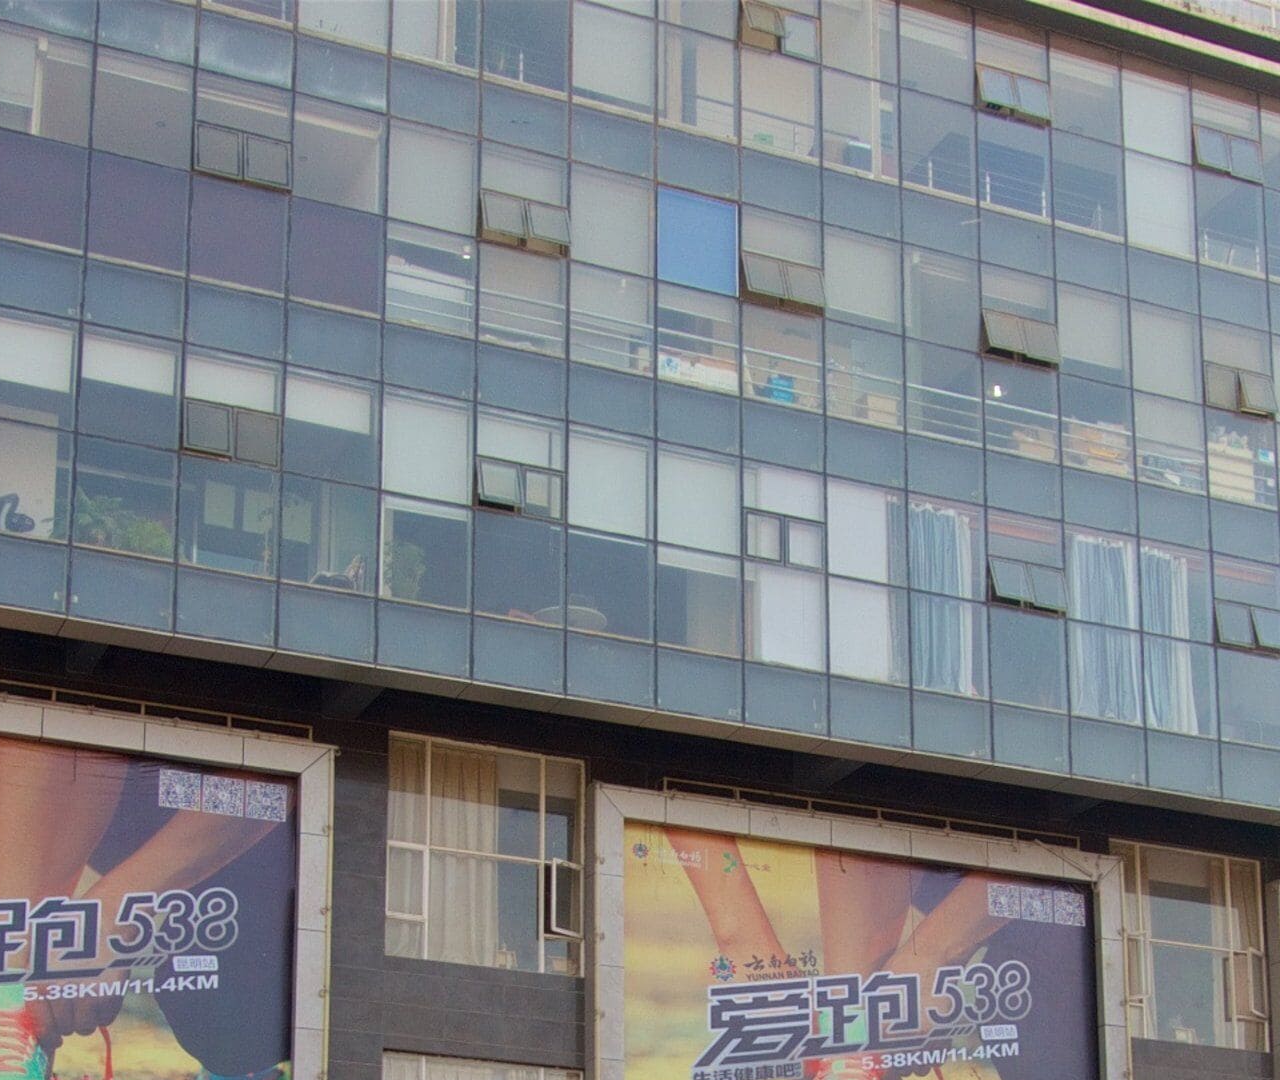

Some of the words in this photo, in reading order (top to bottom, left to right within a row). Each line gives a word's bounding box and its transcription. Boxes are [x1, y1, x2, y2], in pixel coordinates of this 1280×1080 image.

[109, 887, 239, 956] 538
[24, 973, 220, 1002] 5.38KM/11.4KM
[745, 971, 785, 982] YUNNAN
[786, 968, 820, 979] BAIYAO
[927, 960, 1033, 1027] 538
[861, 1042, 1020, 1071] 5.38KM/11.4KM
